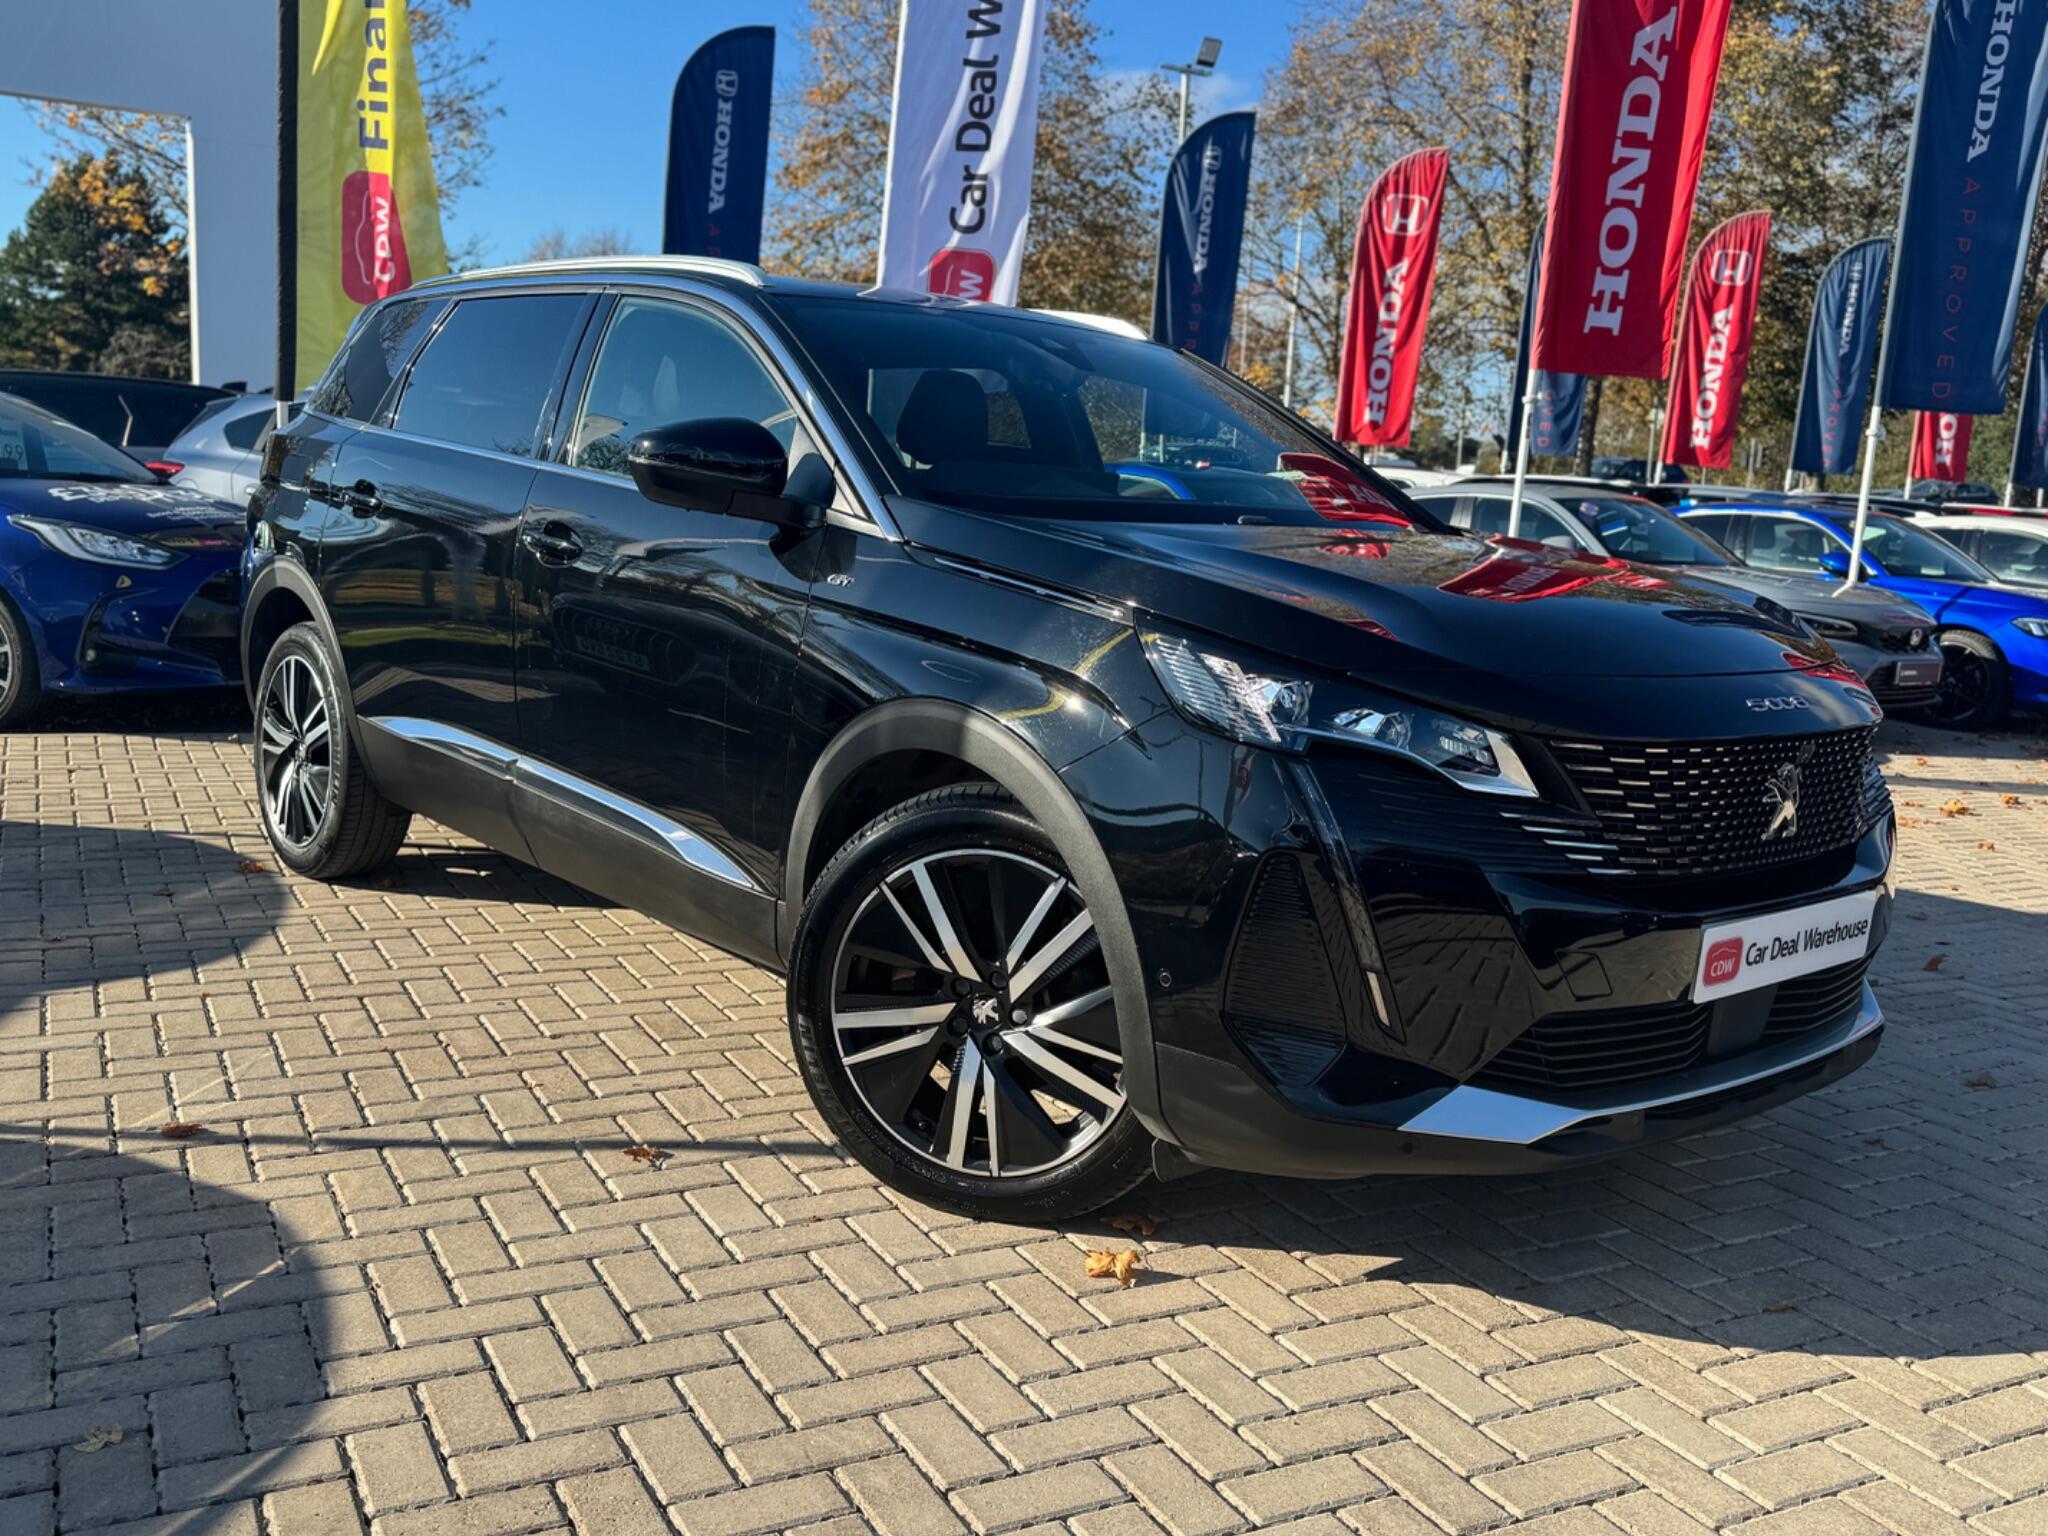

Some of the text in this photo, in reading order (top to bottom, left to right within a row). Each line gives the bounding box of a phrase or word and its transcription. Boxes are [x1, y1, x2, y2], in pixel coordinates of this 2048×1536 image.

[357, 0, 388, 150] Fina
[955, 54, 999, 152] Deal
[1967, 0, 2016, 163] HONDA
[708, 99, 733, 214] HONDA
[949, 164, 988, 234] Car
[1583, 6, 1677, 336] HONDA
[374, 196, 395, 282] CDW
[1193, 170, 1217, 274] HONDA
[1839, 281, 1860, 356] HONDA
[1932, 176, 1981, 399] APPROVED
[1363, 257, 1409, 425] HONDA
[1690, 303, 1734, 449] HONDA
[1936, 413, 1958, 466] HO
[827, 574, 855, 587] GT
[1745, 694, 1809, 711] 5008
[1711, 957, 1735, 977] CDW
[1745, 919, 1868, 966] Car Deal Warehouse
